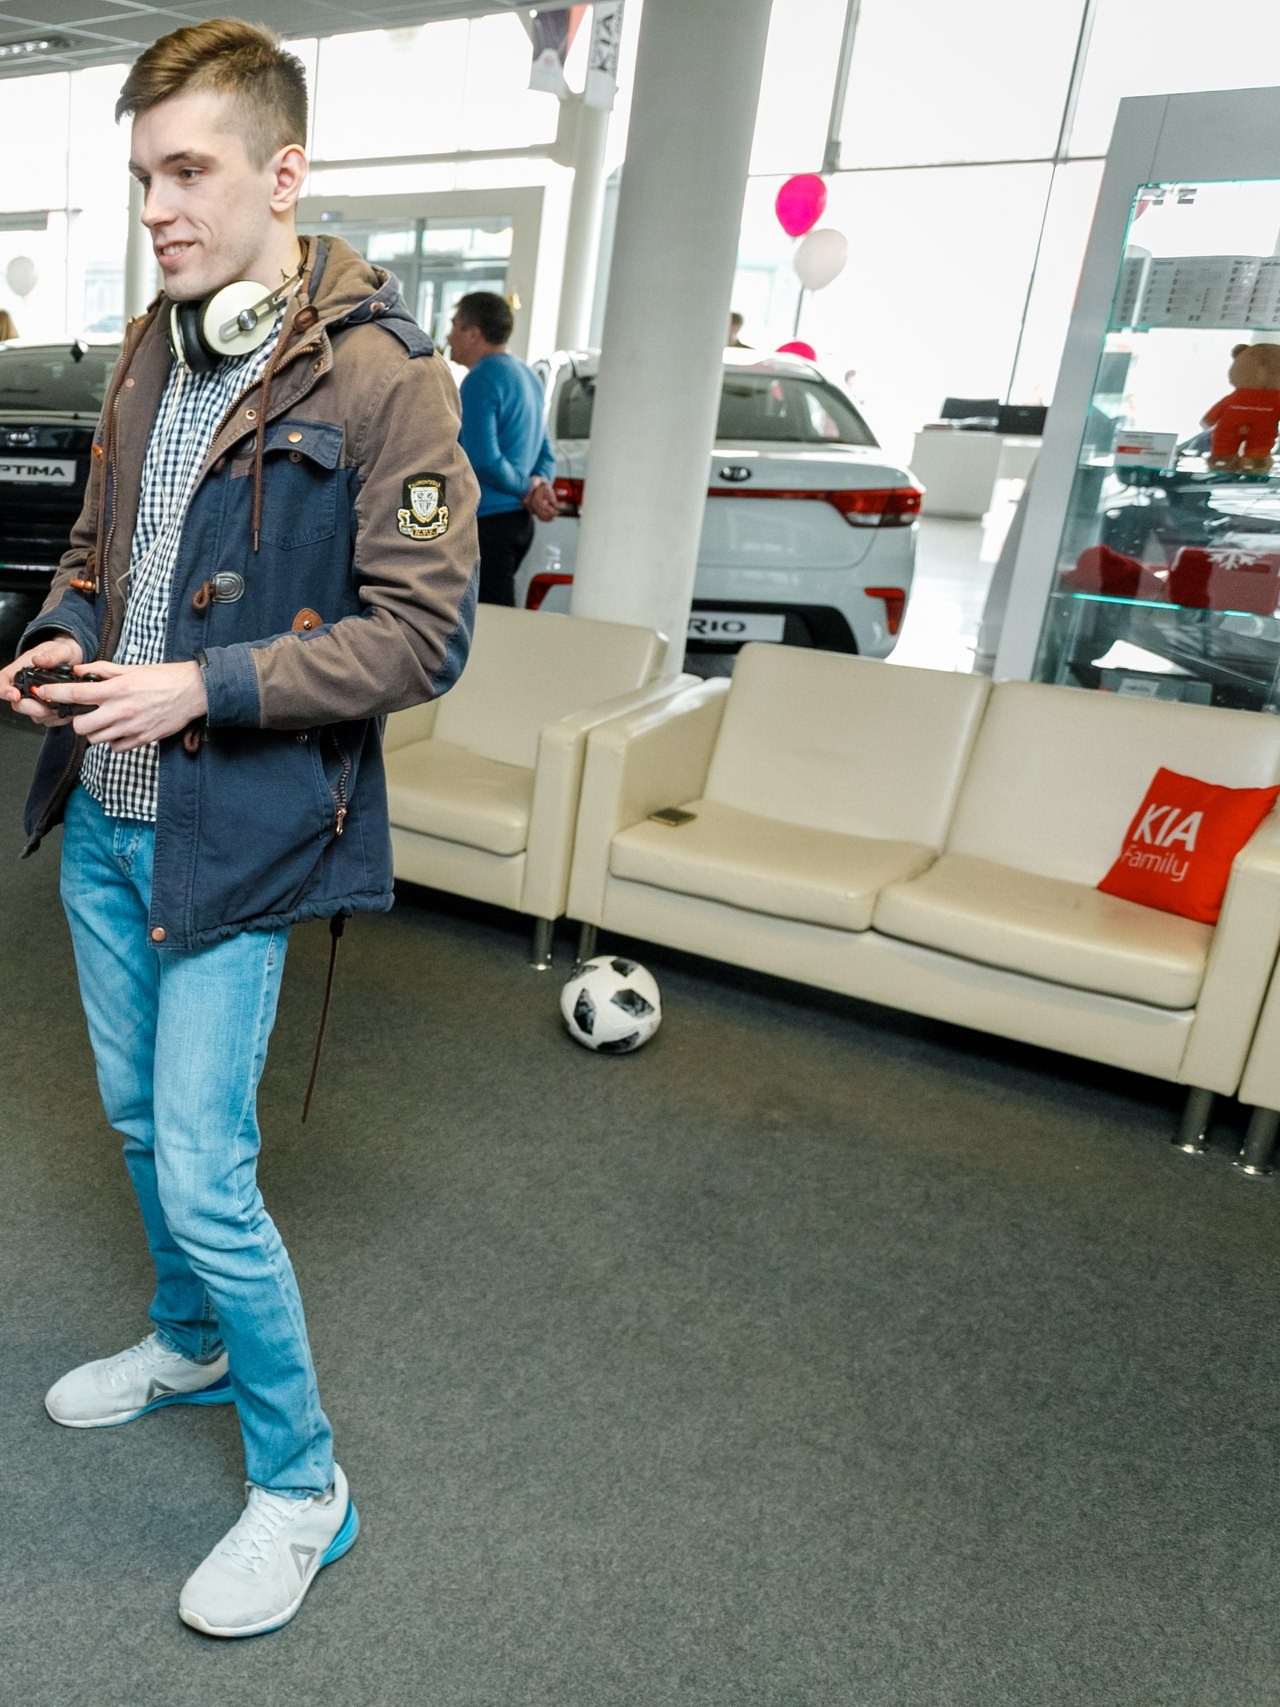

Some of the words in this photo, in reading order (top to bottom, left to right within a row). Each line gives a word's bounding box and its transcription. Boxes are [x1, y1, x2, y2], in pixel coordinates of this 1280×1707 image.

[688, 619, 746, 635] RIO
[1132, 803, 1203, 852] KIA
[1121, 845, 1189, 882] Family
